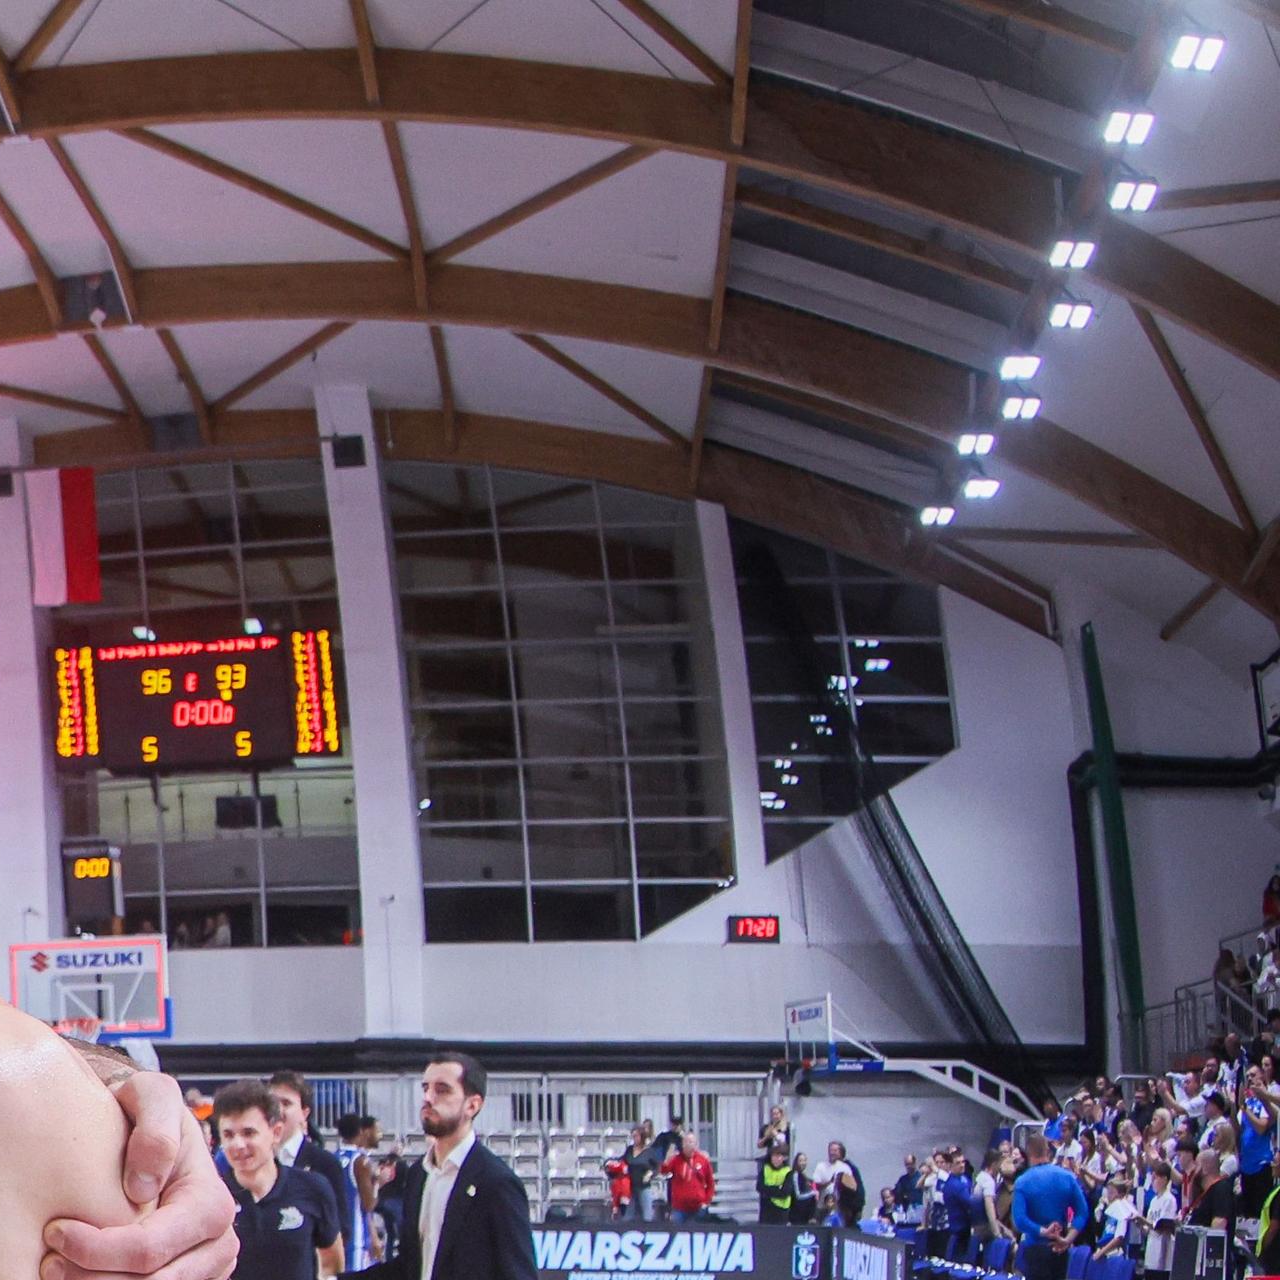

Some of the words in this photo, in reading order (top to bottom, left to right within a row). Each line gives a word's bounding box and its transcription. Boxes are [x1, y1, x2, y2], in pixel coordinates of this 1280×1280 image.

[141, 669, 172, 695] 96
[215, 664, 247, 689] 93
[736, 918, 777, 937] 17:28
[56, 952, 143, 968] SUZUKI
[532, 1231, 755, 1272] WARSZAWA
